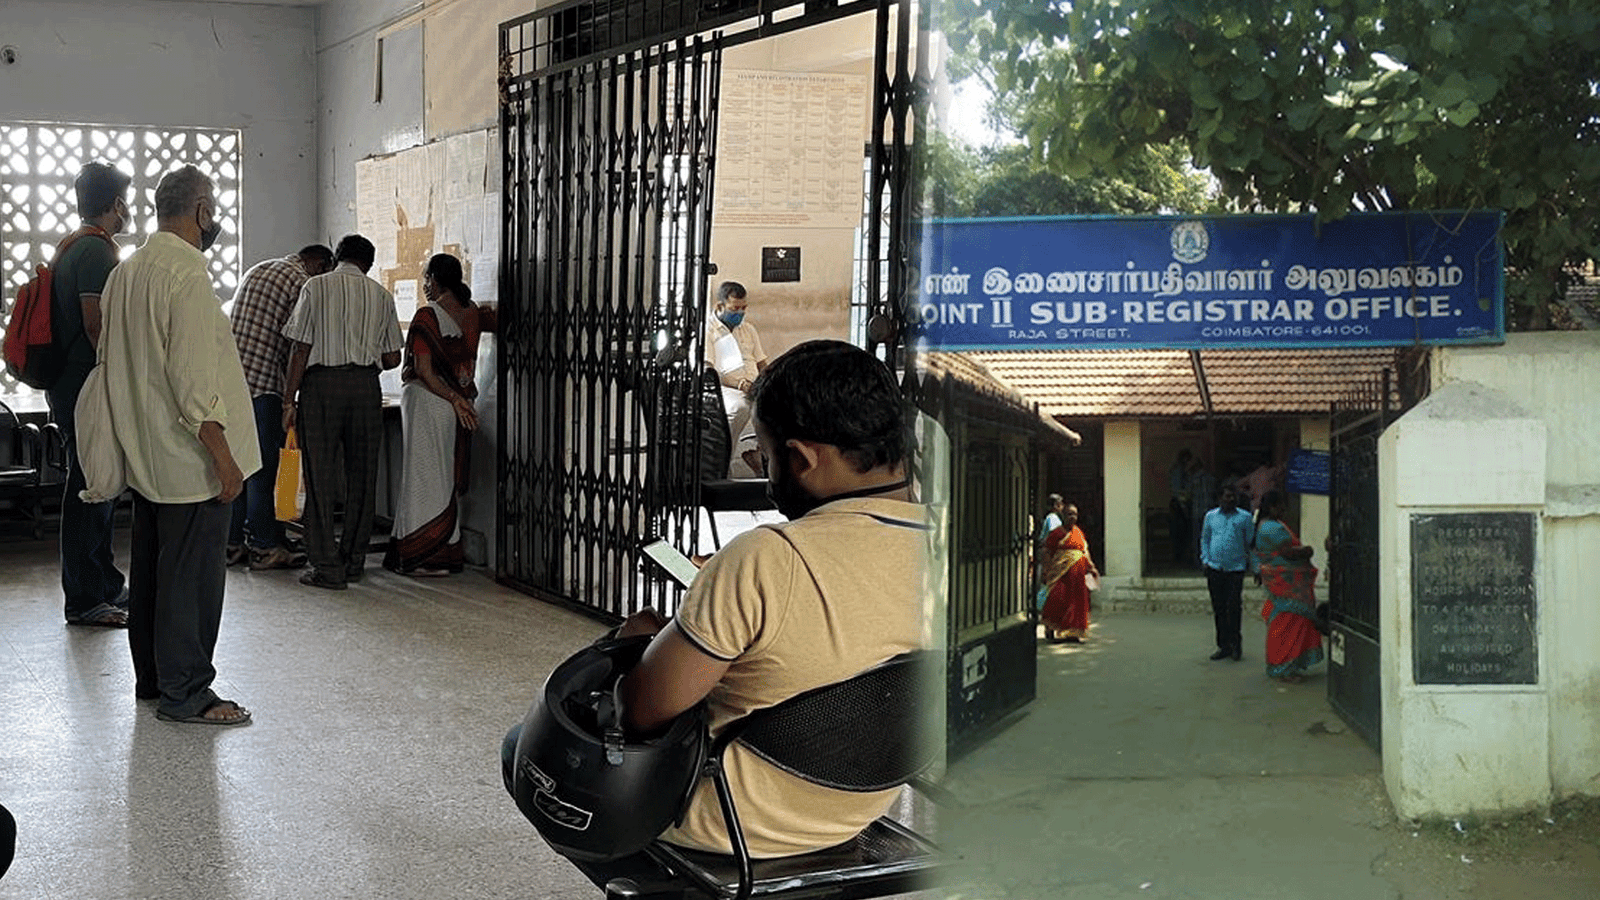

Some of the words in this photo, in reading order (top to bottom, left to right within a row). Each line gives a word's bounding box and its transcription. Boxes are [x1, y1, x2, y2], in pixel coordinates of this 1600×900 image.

[1324, 295, 1462, 321] OFFICE.
[1008, 329, 1048, 339] RAJA
[1422, 605, 1438, 615] TO
